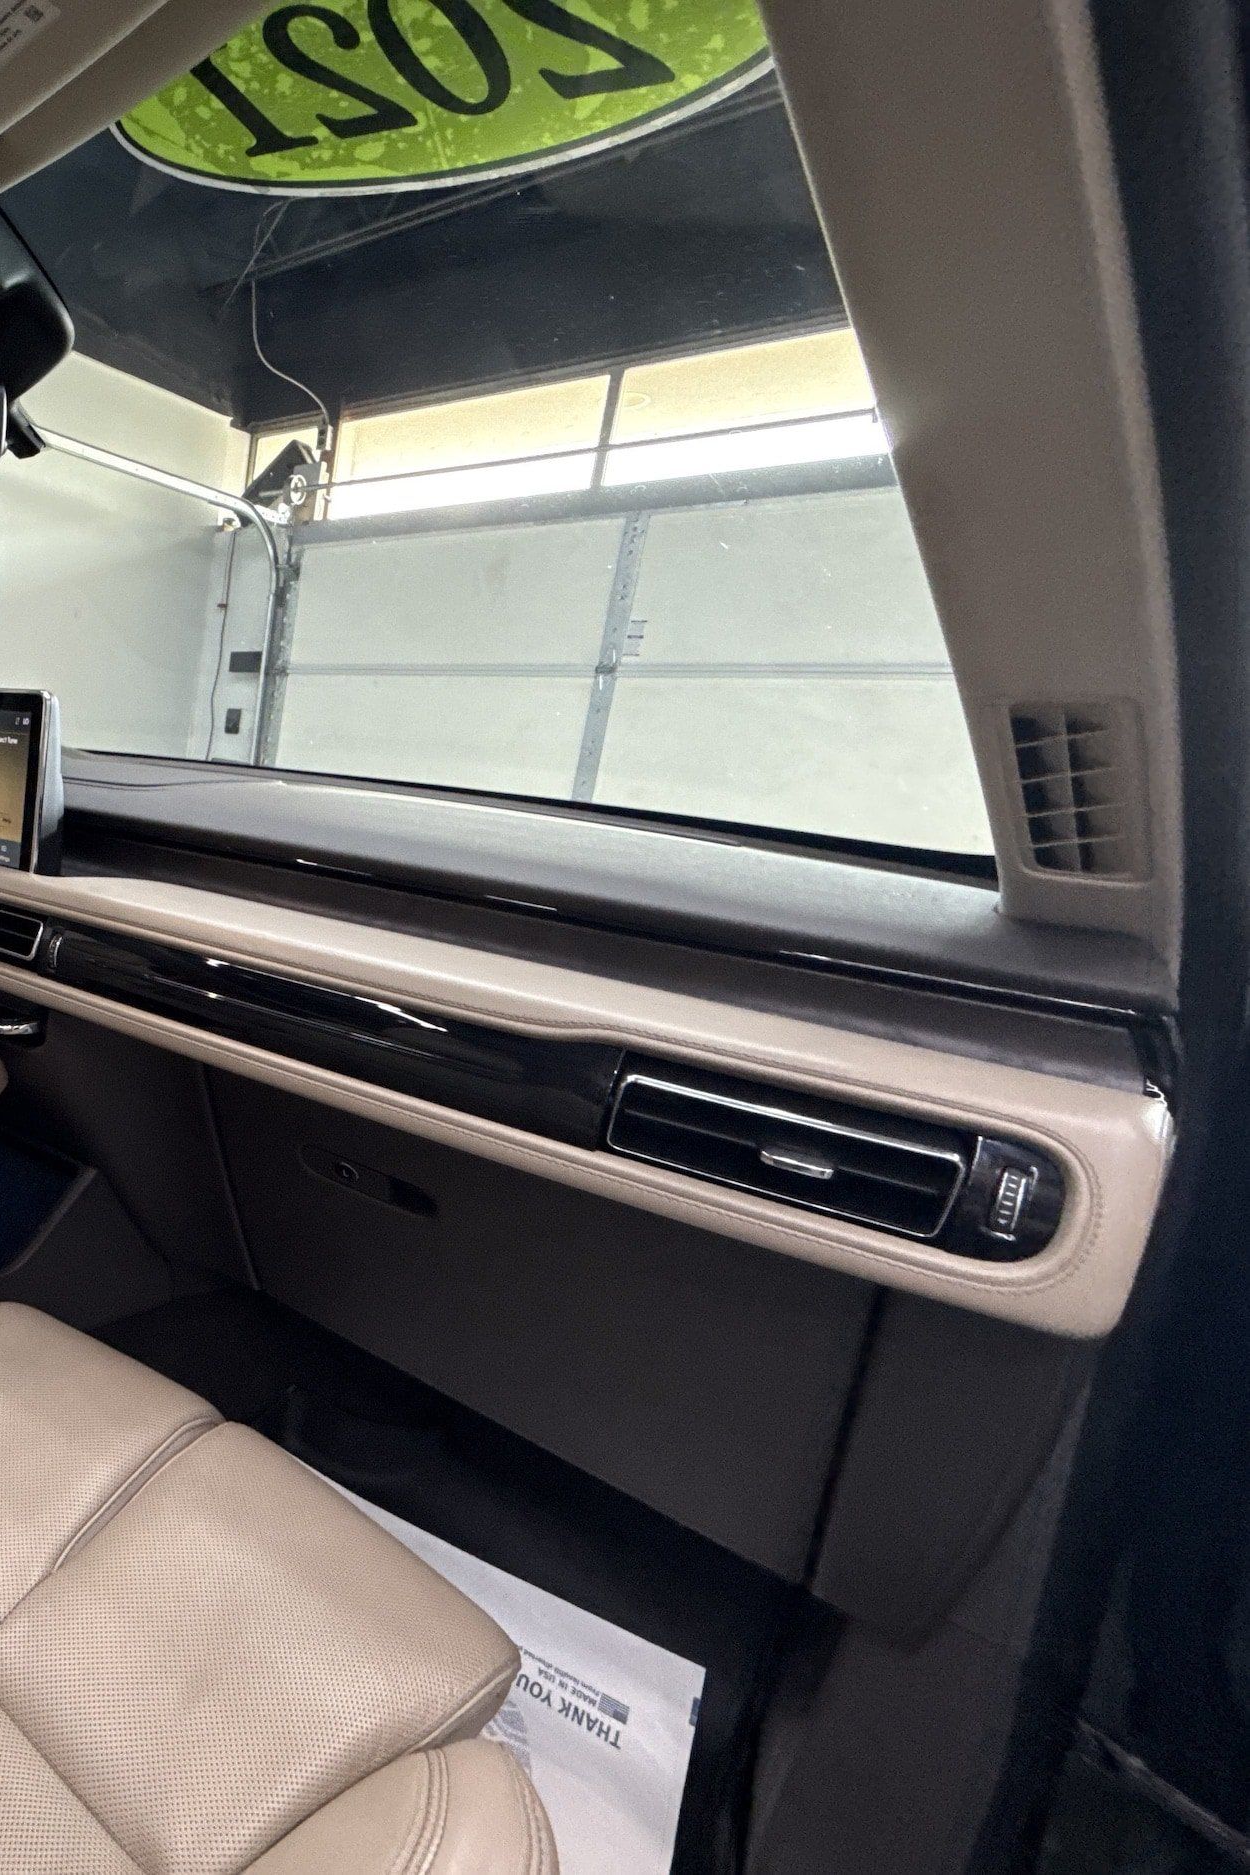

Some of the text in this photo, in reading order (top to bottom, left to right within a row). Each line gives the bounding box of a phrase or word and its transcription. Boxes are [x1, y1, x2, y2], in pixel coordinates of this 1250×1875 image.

[538, 1667, 556, 1683] USA
[558, 1679, 568, 1690] IN
[515, 1673, 553, 1708] YOU
[570, 1685, 597, 1707] MADE
[557, 1696, 621, 1750] THANK
